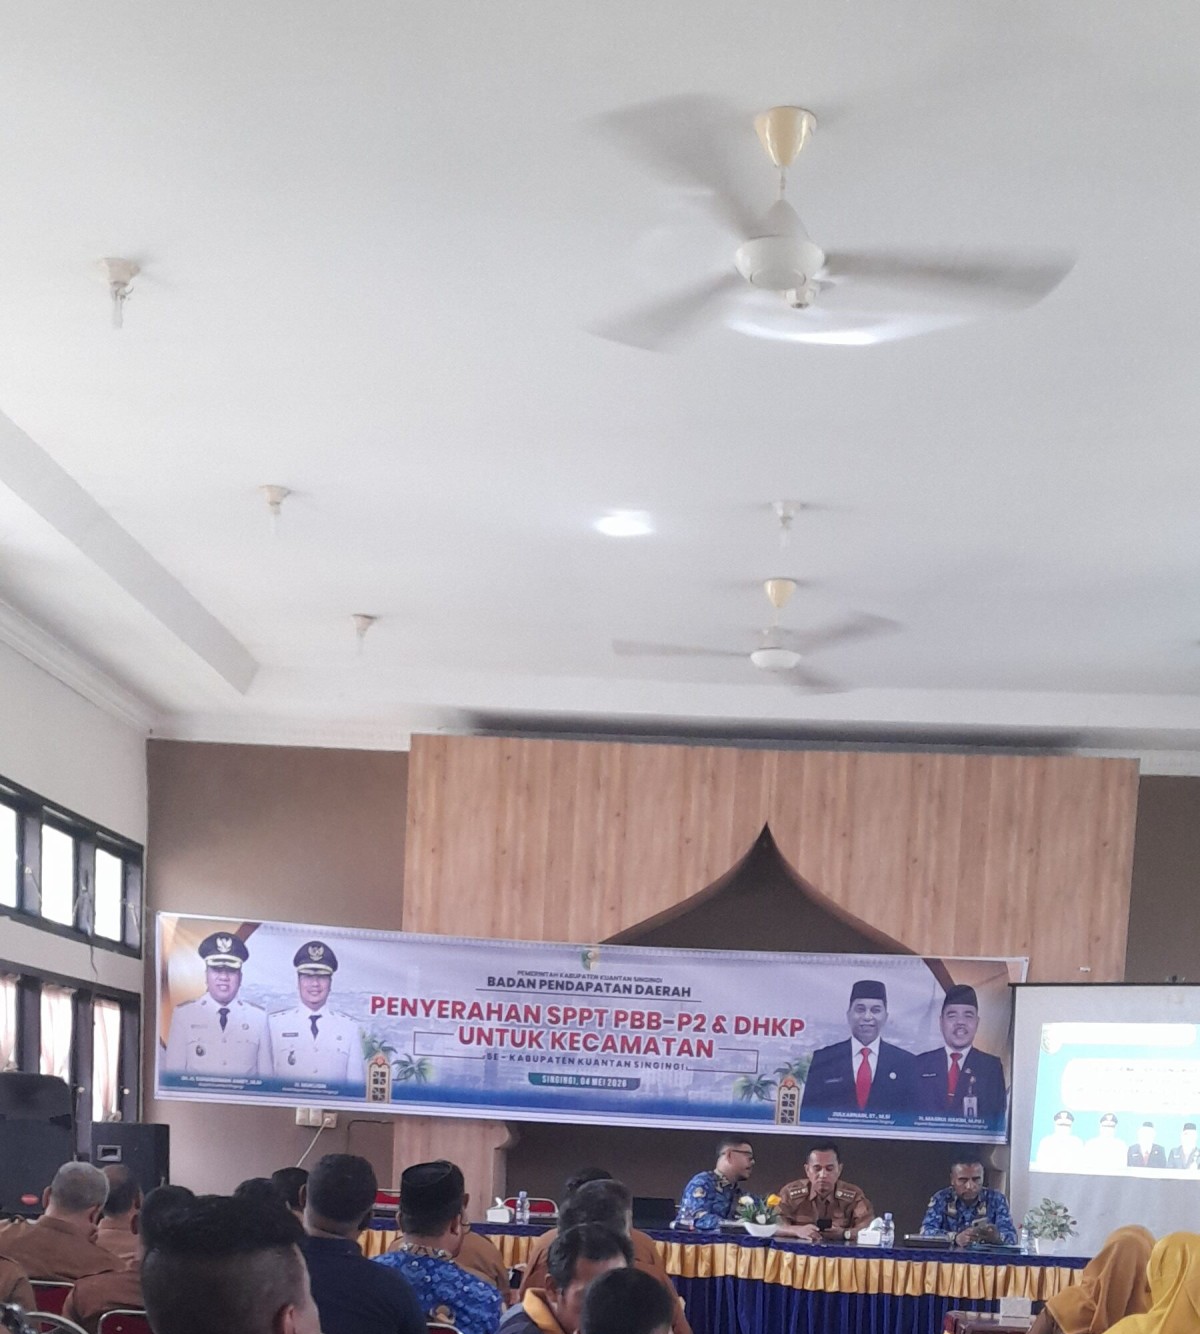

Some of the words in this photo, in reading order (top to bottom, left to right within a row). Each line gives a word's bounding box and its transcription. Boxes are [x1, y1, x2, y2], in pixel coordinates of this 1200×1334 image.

[487, 976, 536, 989] BADAN
[539, 979, 632, 994] PENDAPATAN
[635, 984, 691, 997] DAERAH
[371, 996, 541, 1024] PENYERAHAN
[547, 1006, 609, 1027] SPPT
[614, 1010, 706, 1033] PBB-P2
[712, 1015, 728, 1034] &
[734, 1016, 805, 1037] DHKP
[459, 1026, 544, 1049] UNTUK
[551, 1031, 714, 1058] KECAMATAN
[510, 1054, 575, 1065] KABUPATEN
[578, 1058, 631, 1068] KUANTAN
[591, 1078, 605, 1086] MEI
